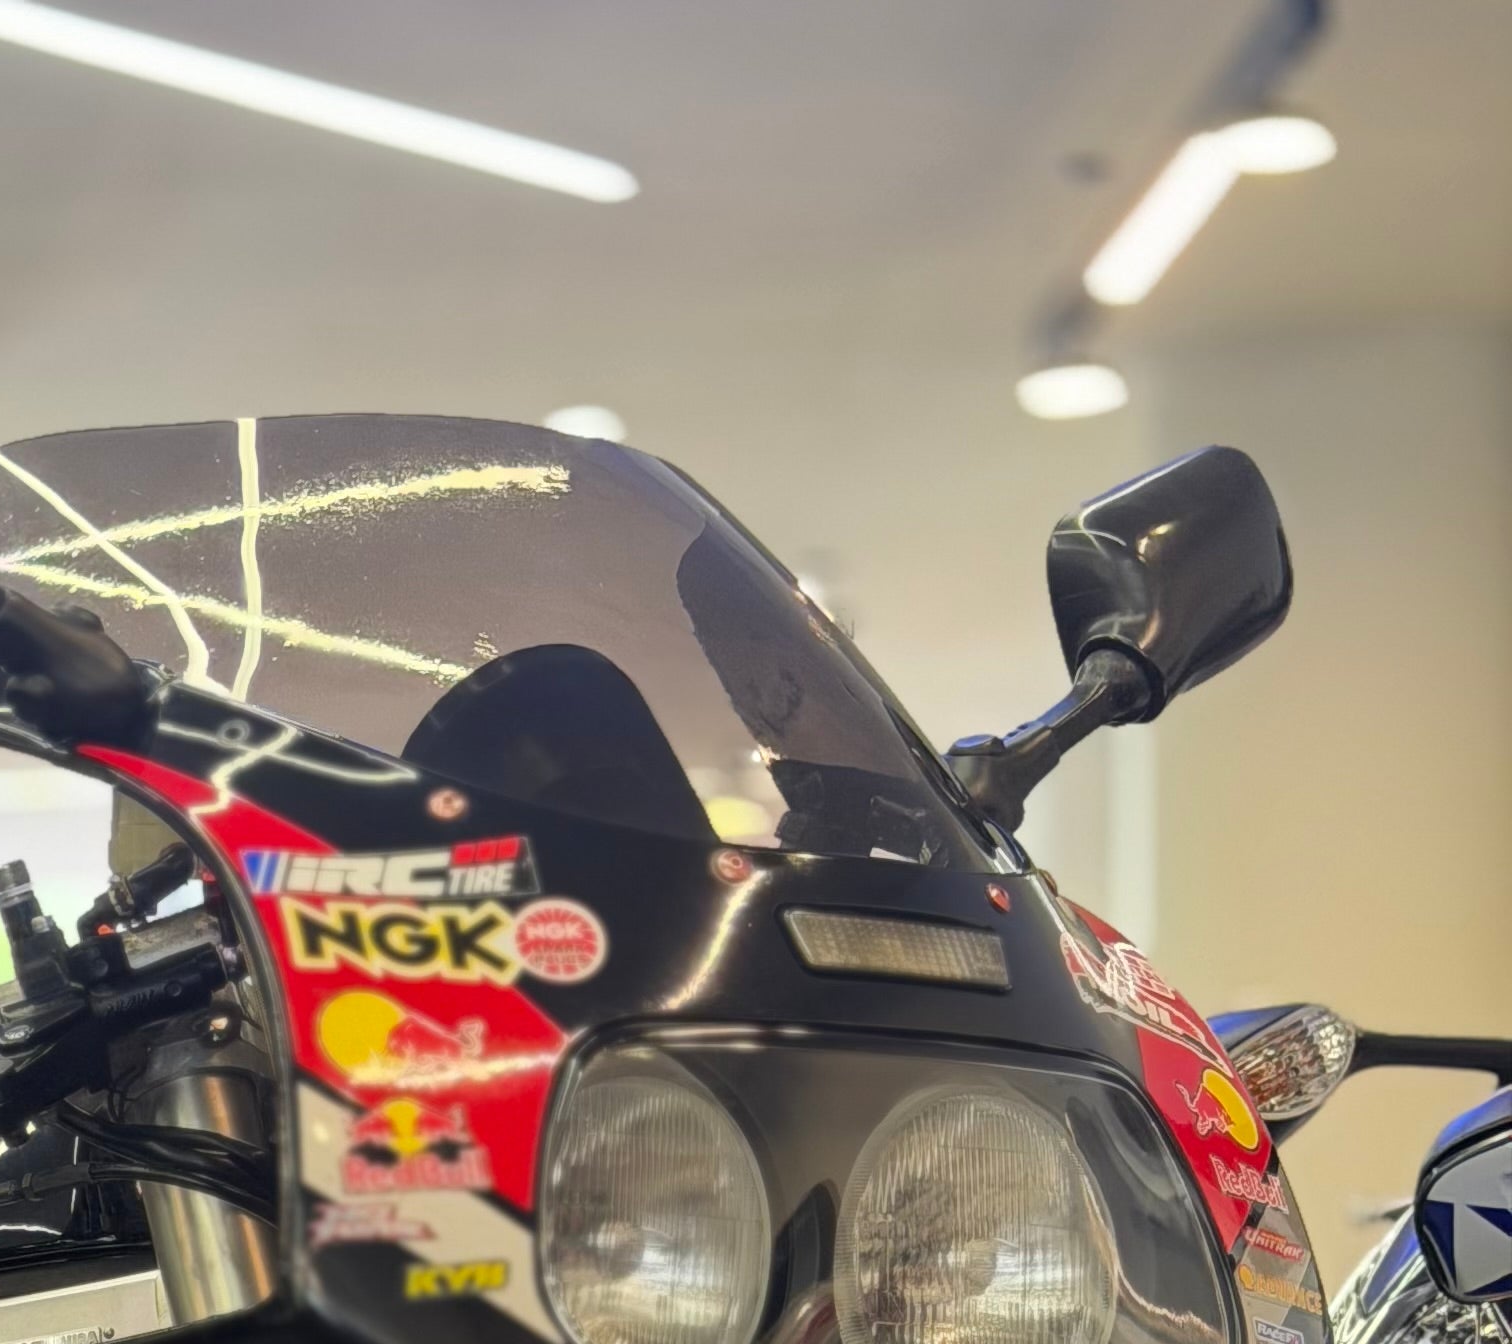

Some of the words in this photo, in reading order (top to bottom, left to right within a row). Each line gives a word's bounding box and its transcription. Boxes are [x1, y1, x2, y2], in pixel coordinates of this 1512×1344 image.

[448, 861, 515, 896] TIRE
[292, 906, 511, 971] NGK
[526, 921, 584, 941] NGK
[405, 1261, 509, 1298] KYB
